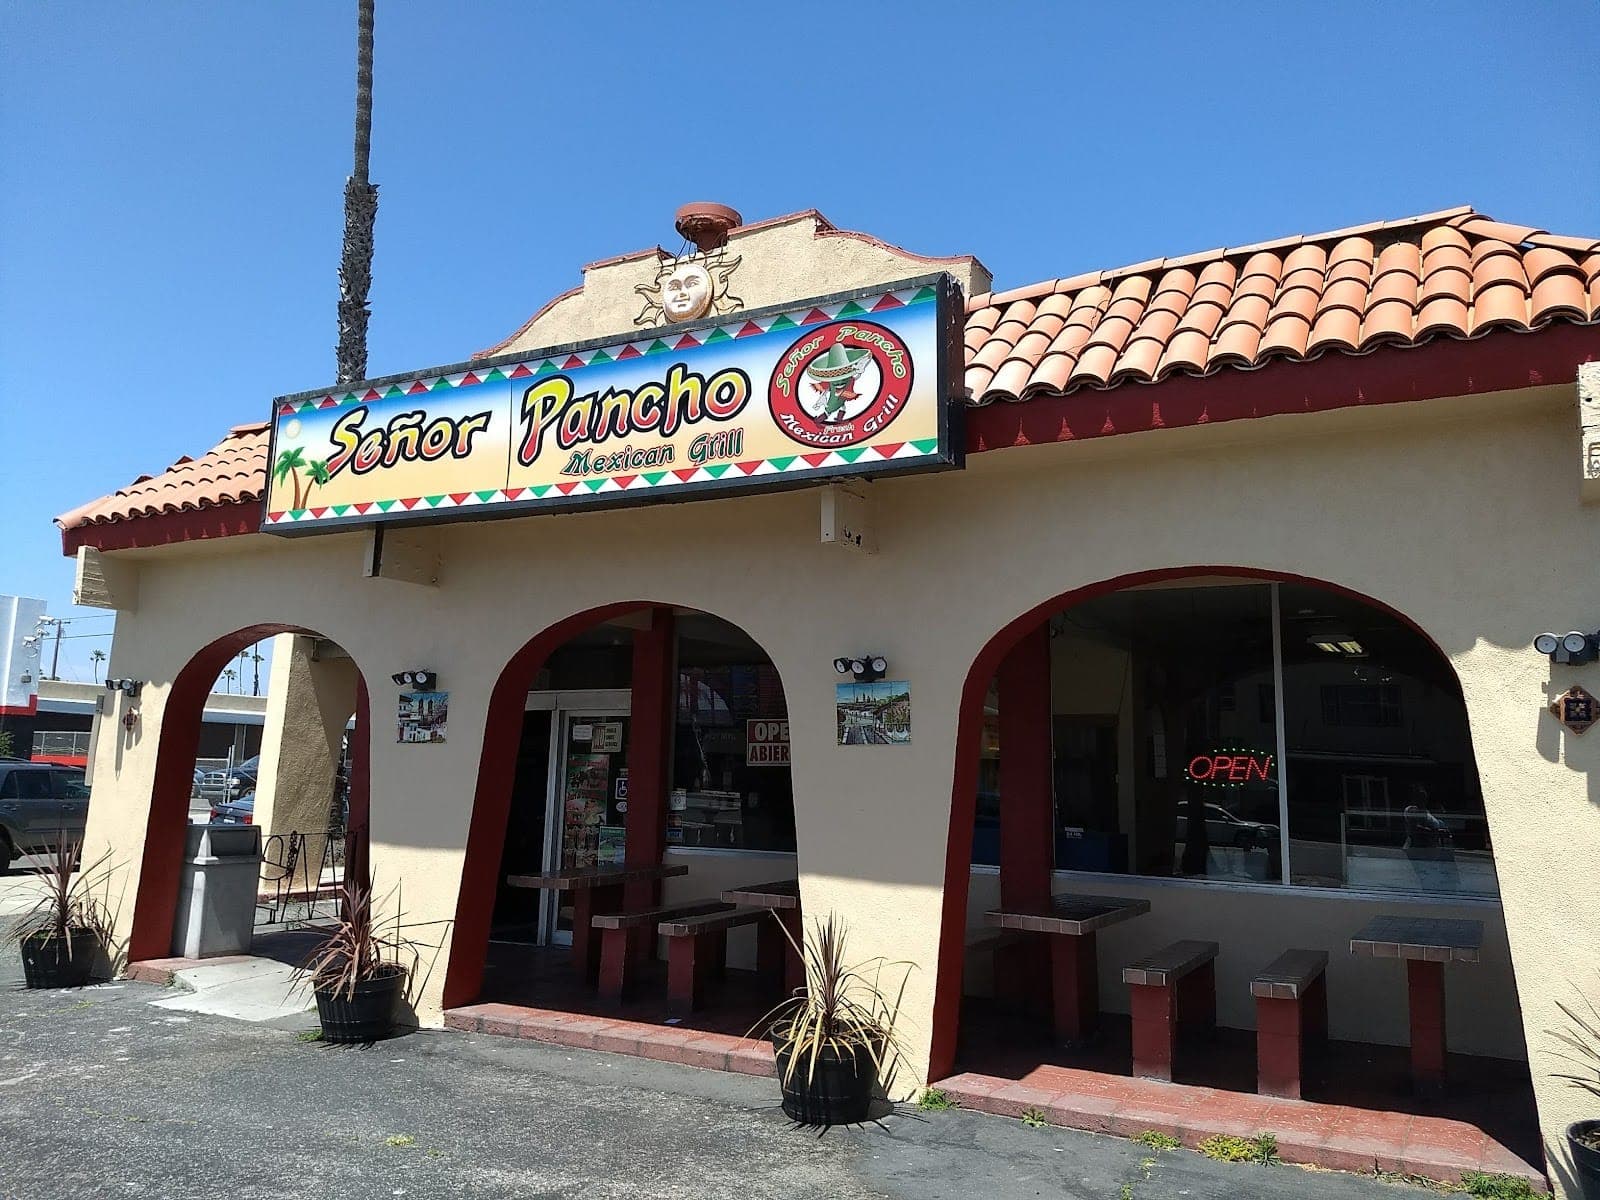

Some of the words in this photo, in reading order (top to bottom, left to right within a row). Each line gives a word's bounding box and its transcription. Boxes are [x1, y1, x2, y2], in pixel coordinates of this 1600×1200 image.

[776, 336, 824, 397] Señor
[836, 326, 907, 378] Pancho
[325, 405, 492, 484] Señor
[518, 363, 752, 467] Pancho
[780, 413, 853, 443] Mexican
[863, 394, 899, 432] Grill
[560, 445, 675, 476] Mexican
[688, 427, 744, 467] Grill
[1189, 755, 1271, 781] OPEN
